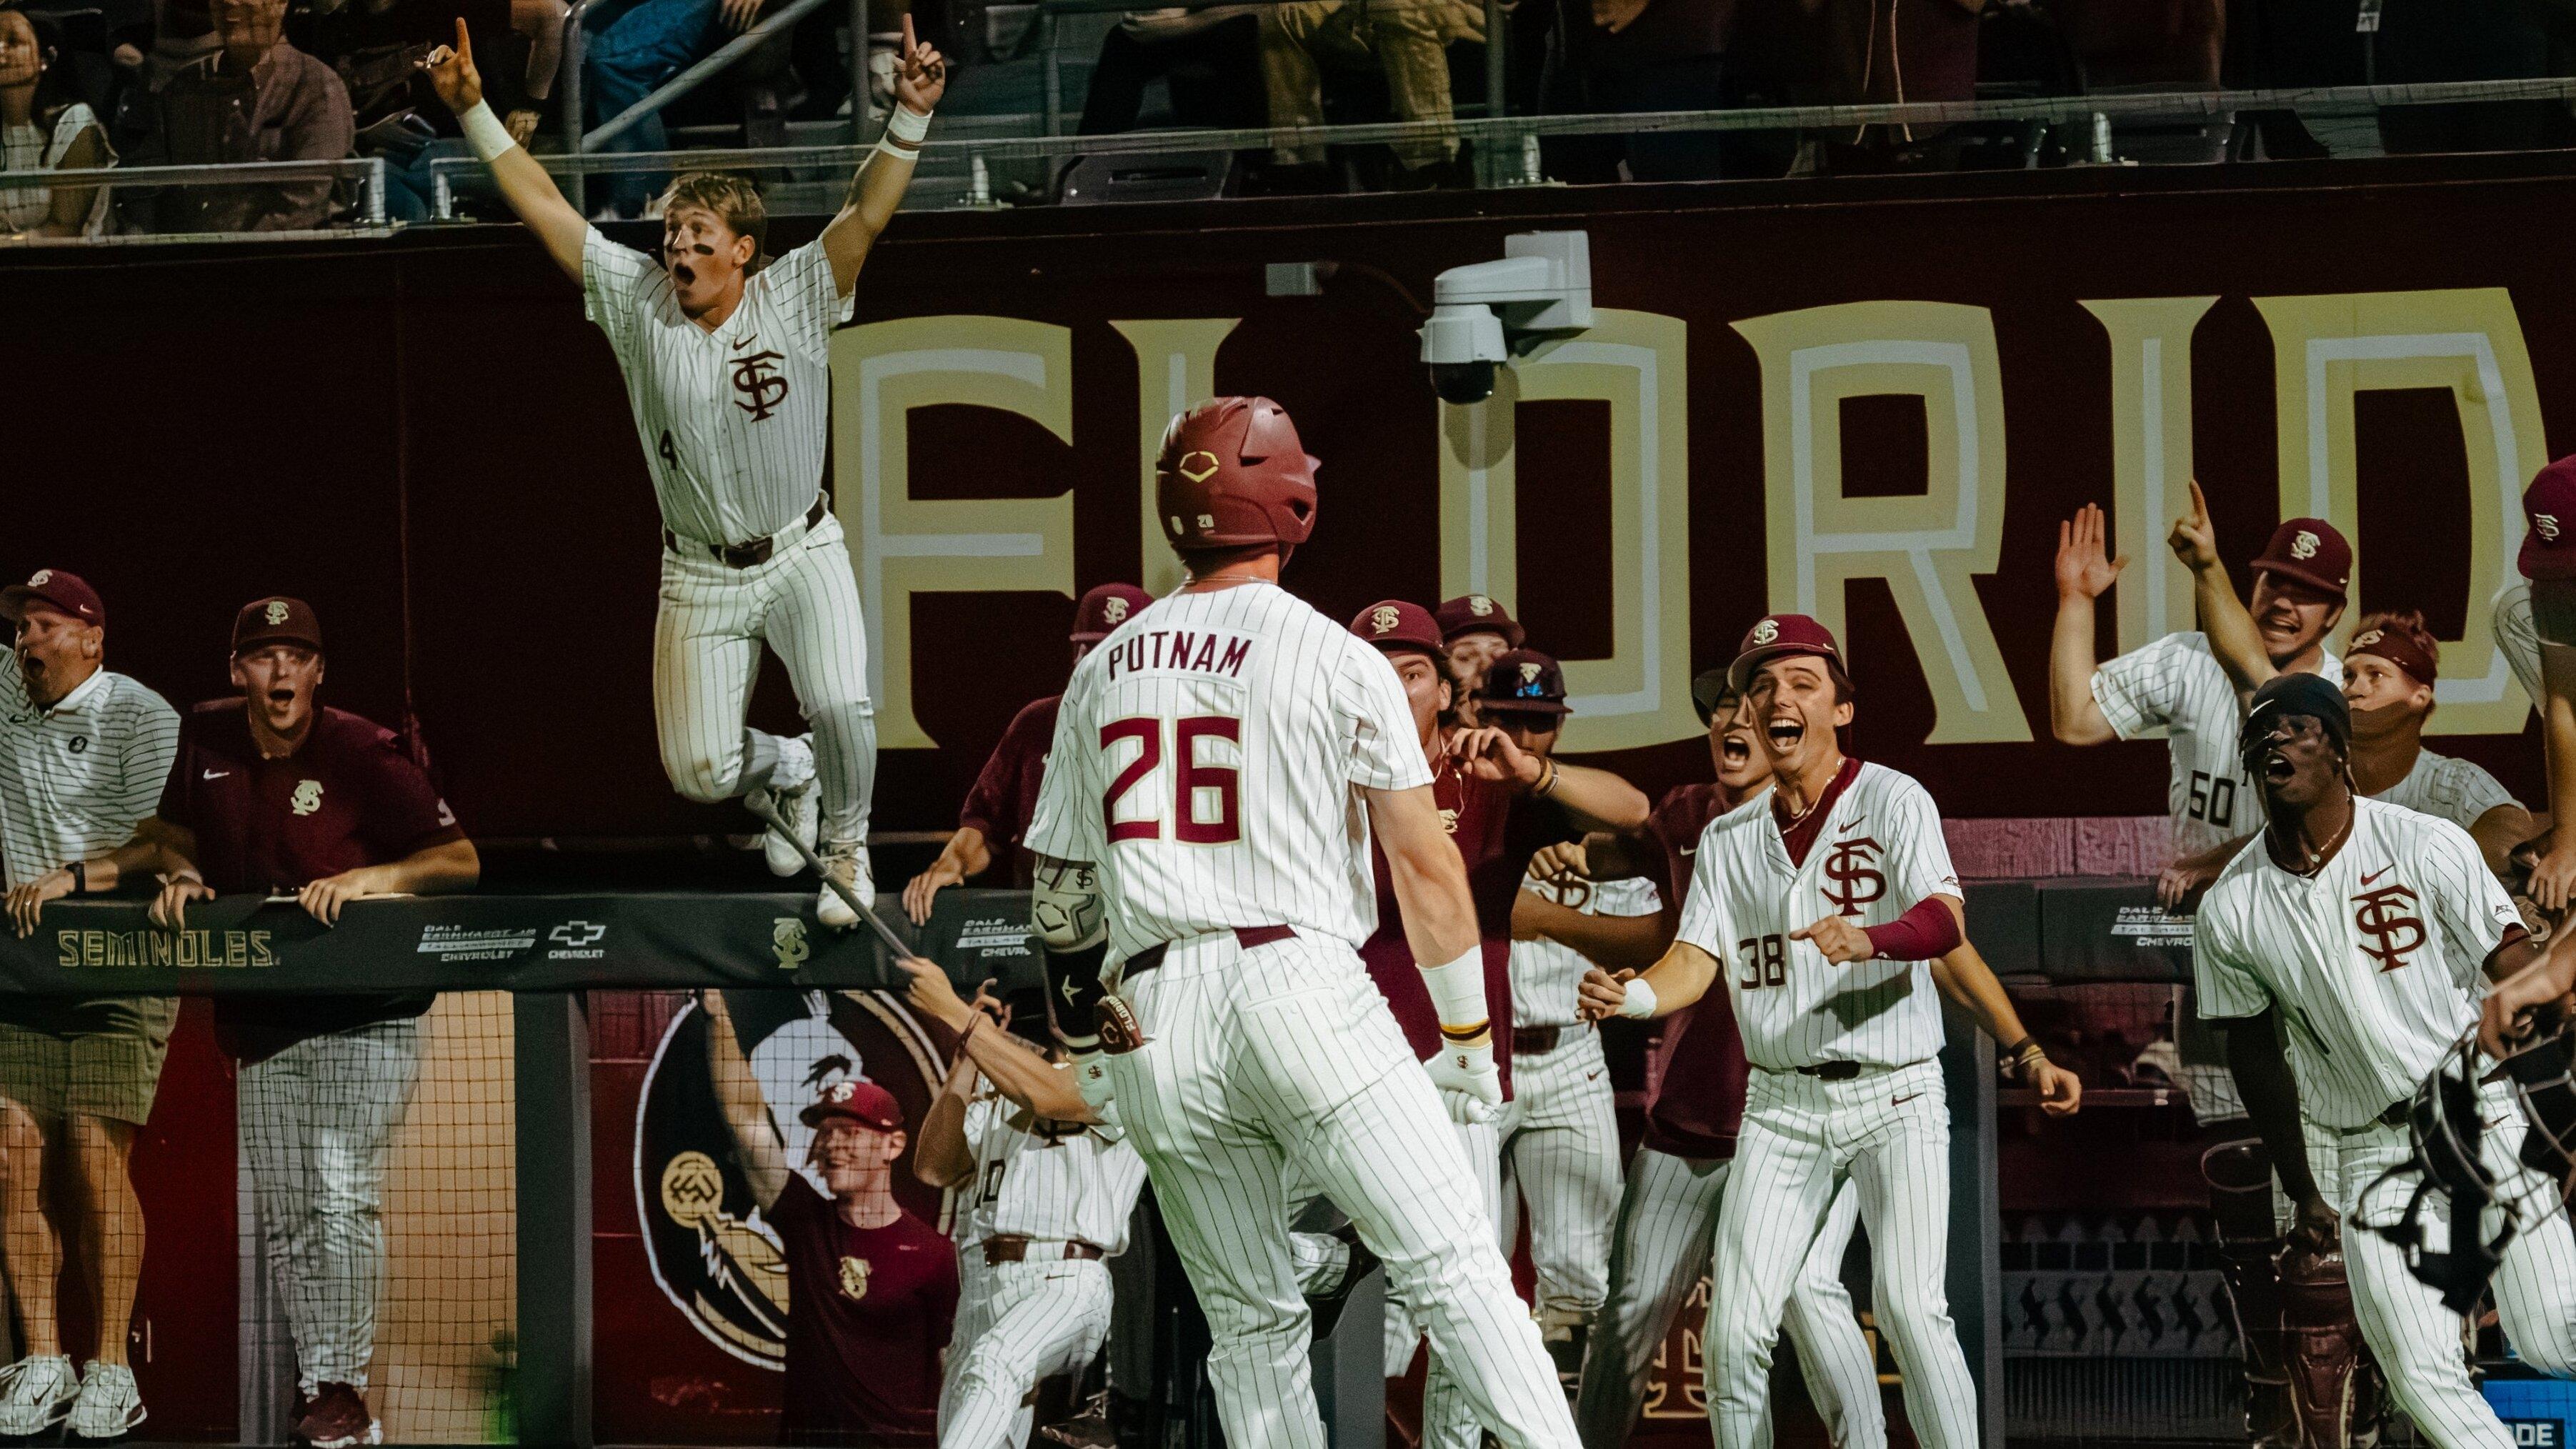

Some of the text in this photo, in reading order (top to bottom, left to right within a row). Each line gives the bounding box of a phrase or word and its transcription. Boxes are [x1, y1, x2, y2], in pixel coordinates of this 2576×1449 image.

[659, 429, 677, 470] 4
[1109, 631, 1252, 682] PUTNAM
[1099, 714, 1242, 846] 26
[2189, 770, 2236, 828] 50
[59, 930, 273, 967] SEMINOLES
[1738, 933, 1786, 990] 38
